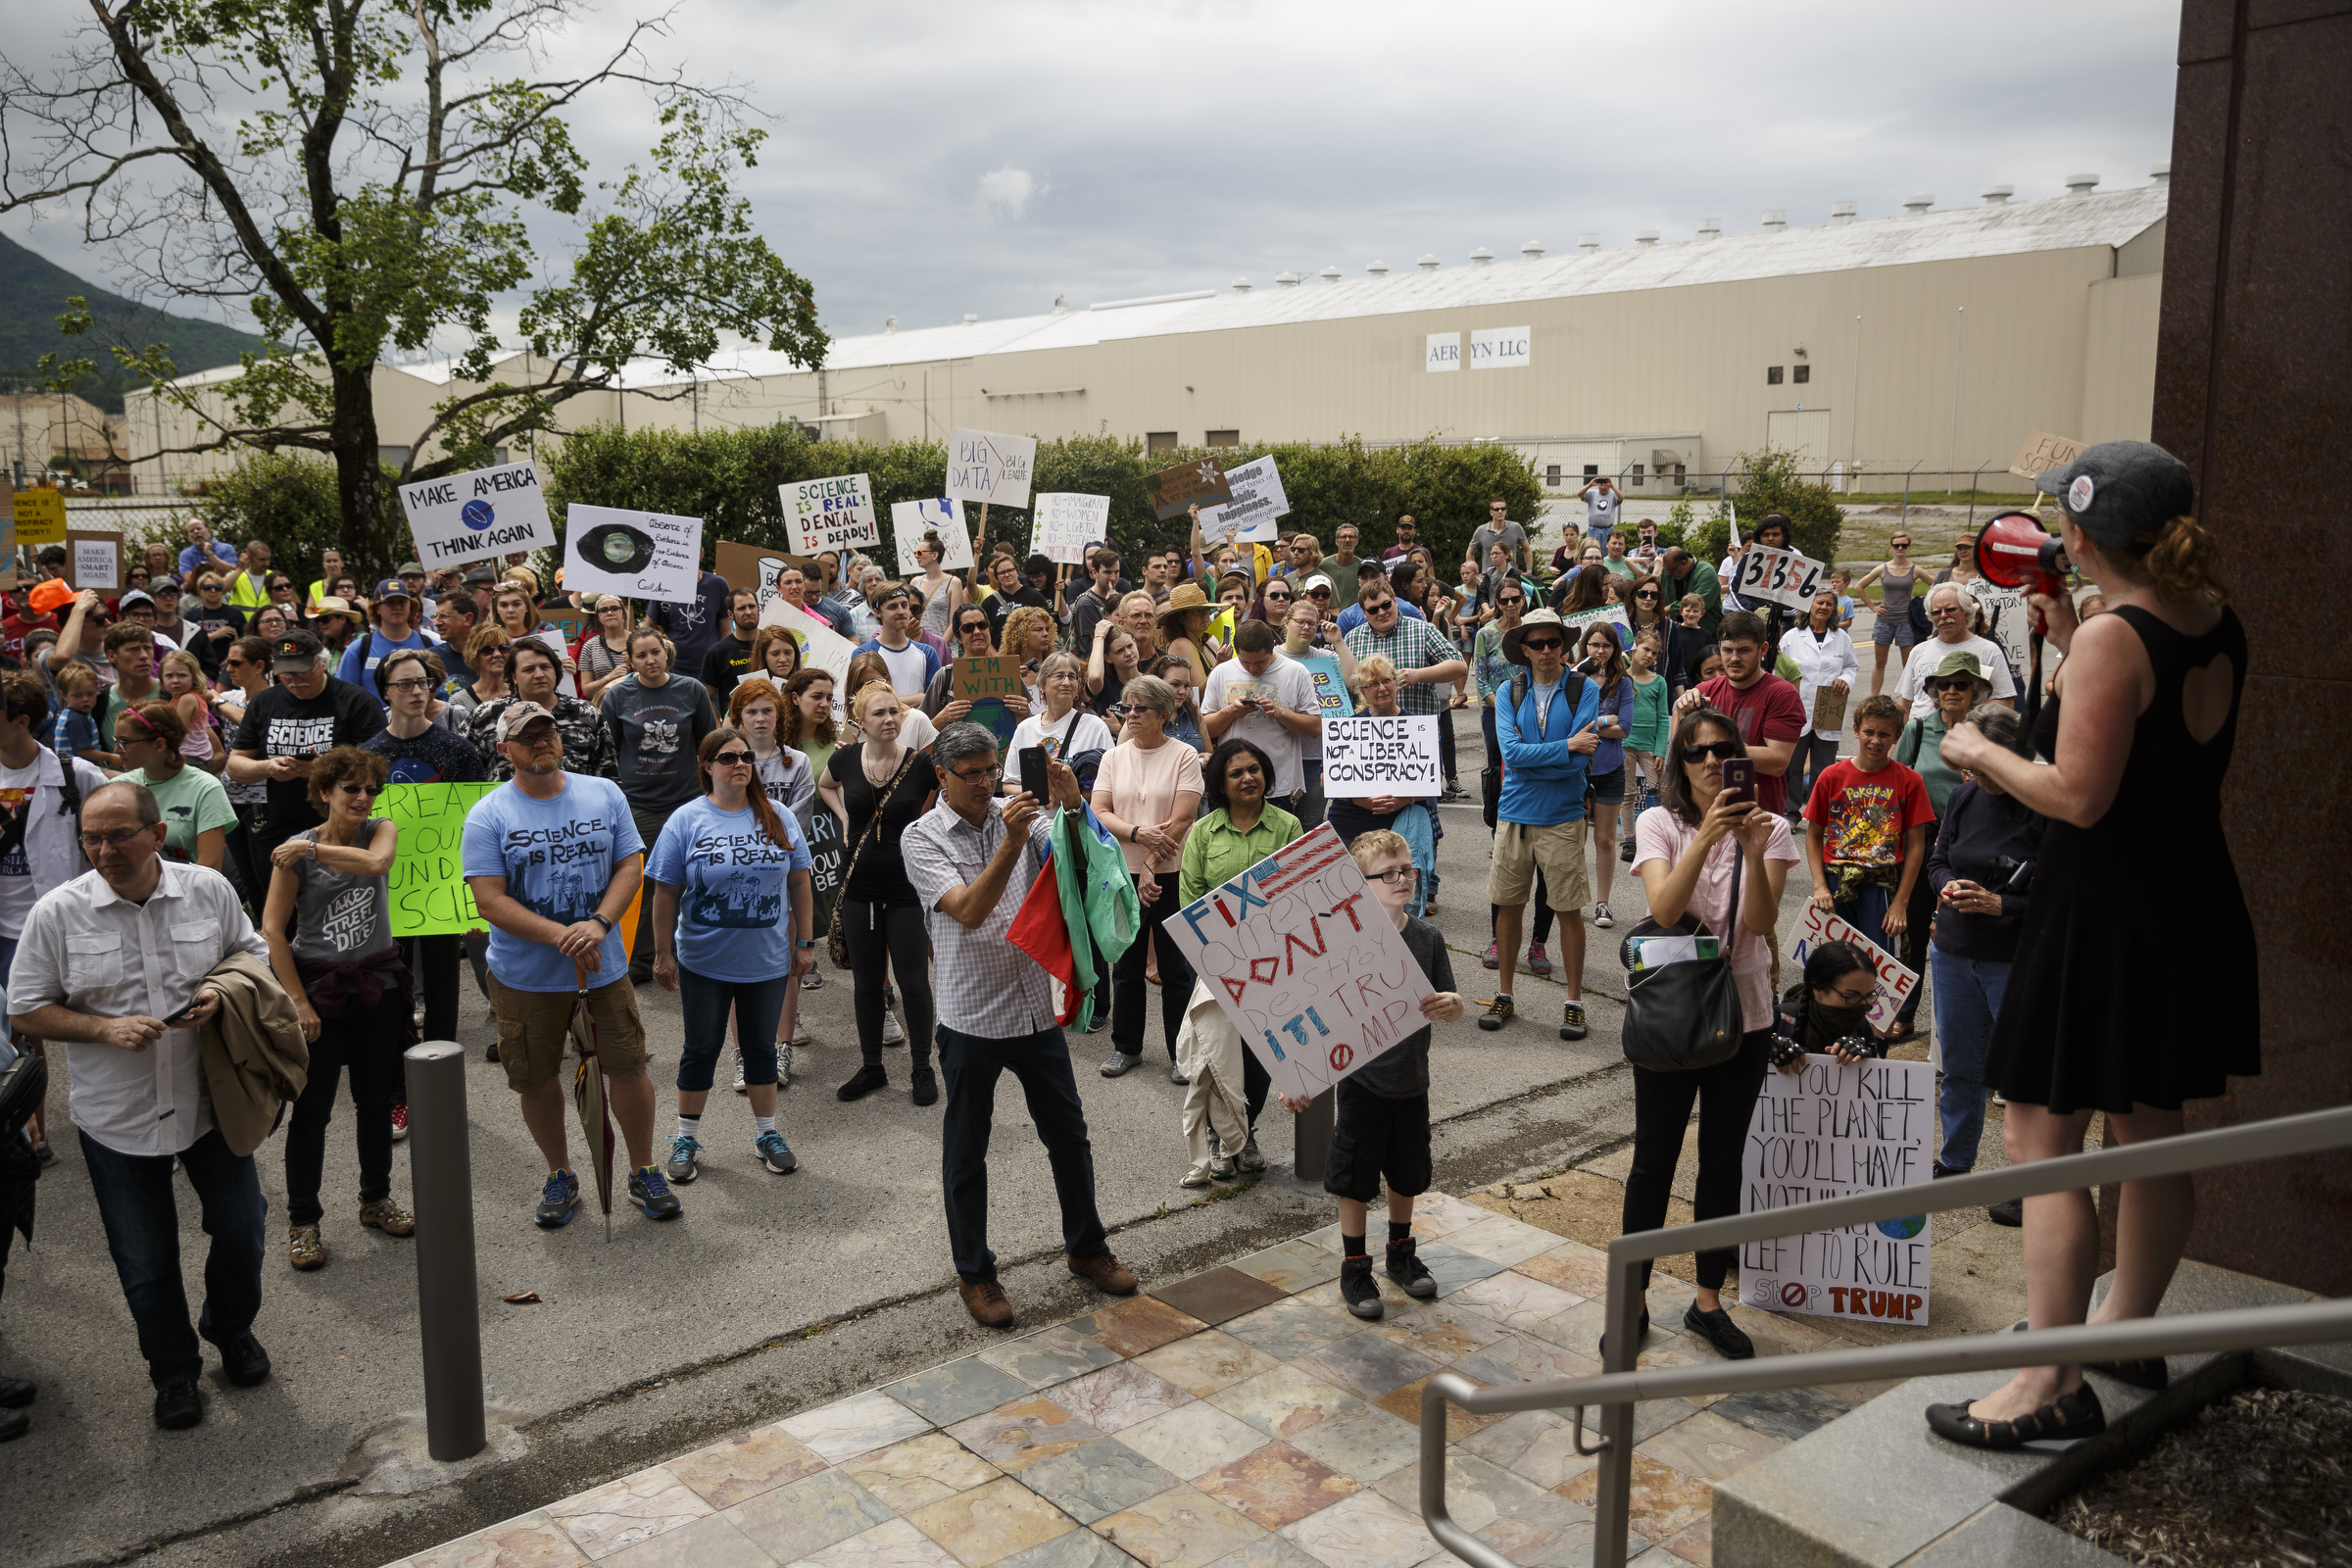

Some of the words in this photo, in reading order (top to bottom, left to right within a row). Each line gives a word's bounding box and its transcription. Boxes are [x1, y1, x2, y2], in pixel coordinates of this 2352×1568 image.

[1430, 345, 1459, 362] AER
[1498, 339, 1527, 357] LLC
[960, 441, 988, 464] BIG
[1005, 455, 1026, 469] BIG
[409, 483, 458, 510] MAKE
[473, 467, 537, 497] AMERICA
[799, 477, 858, 500] SCIENCE
[953, 466, 991, 490] DATA
[1247, 477, 1264, 489] basis
[1264, 471, 1274, 482] of
[796, 500, 812, 514] IS
[1241, 505, 1282, 524] Washington
[683, 524, 694, 538] of
[800, 510, 858, 532] DENIAL
[426, 533, 486, 558] THINK
[488, 523, 534, 547] AGAIN
[803, 535, 818, 550] IS
[827, 521, 875, 544] DEADLY!
[652, 558, 662, 568] of
[1971, 581, 1992, 595] THINK
[1984, 596, 2022, 610] PROTON
[1568, 612, 1600, 626] Respect
[966, 658, 1001, 674] I'M
[962, 677, 1015, 696] WITH
[298, 717, 315, 726] THING
[316, 716, 335, 725] ABOUT
[1328, 719, 1409, 741] SCIENCE
[267, 724, 334, 746] SCIENCE
[267, 744, 276, 755] IS
[277, 745, 297, 755] THAT
[1326, 745, 1349, 760] NOT
[1360, 741, 1430, 760] LIBERAL
[1328, 761, 1436, 783] CONSPIRACY!
[504, 818, 607, 852] SCIENCE
[529, 851, 546, 866] IS
[550, 841, 607, 865] REAL
[710, 851, 725, 866] IS
[732, 847, 785, 865] REAL
[814, 870, 838, 892] BE
[326, 886, 375, 920] LAKE
[322, 900, 377, 941] STREET
[336, 922, 370, 953] DIVE
[1796, 1063, 1842, 1096] YOU
[1858, 1066, 1924, 1101] KILL
[1757, 1096, 1805, 1134] THE
[1818, 1099, 1921, 1146] PLANET,
[1751, 1135, 1846, 1184] YOU'LL
[1852, 1144, 1919, 1187] HAVE
[1744, 1233, 1811, 1275] LEFT
[1819, 1233, 1841, 1279] TO
[1829, 1287, 1923, 1321] TRUMP
